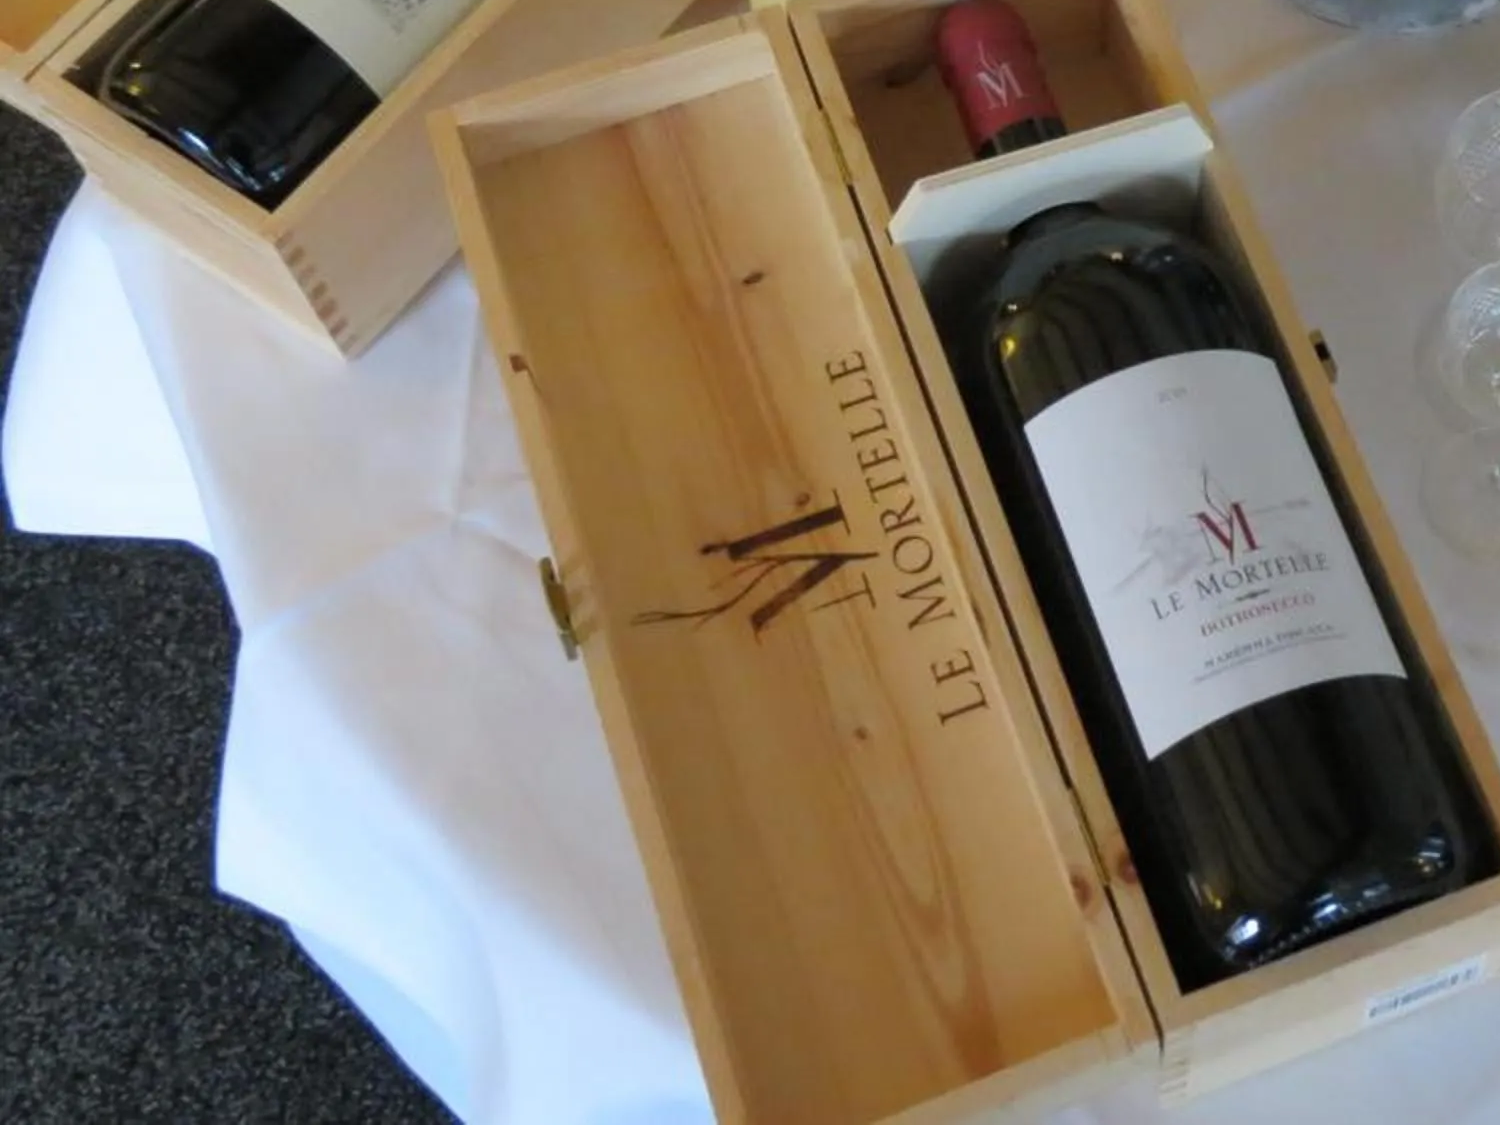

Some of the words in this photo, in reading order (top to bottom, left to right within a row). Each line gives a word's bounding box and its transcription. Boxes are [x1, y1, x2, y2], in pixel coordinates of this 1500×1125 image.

[824, 349, 957, 631] MORTELLE
[1151, 591, 1185, 621] LE
[1193, 553, 1330, 599] MORTELLE
[931, 648, 990, 726] LE
